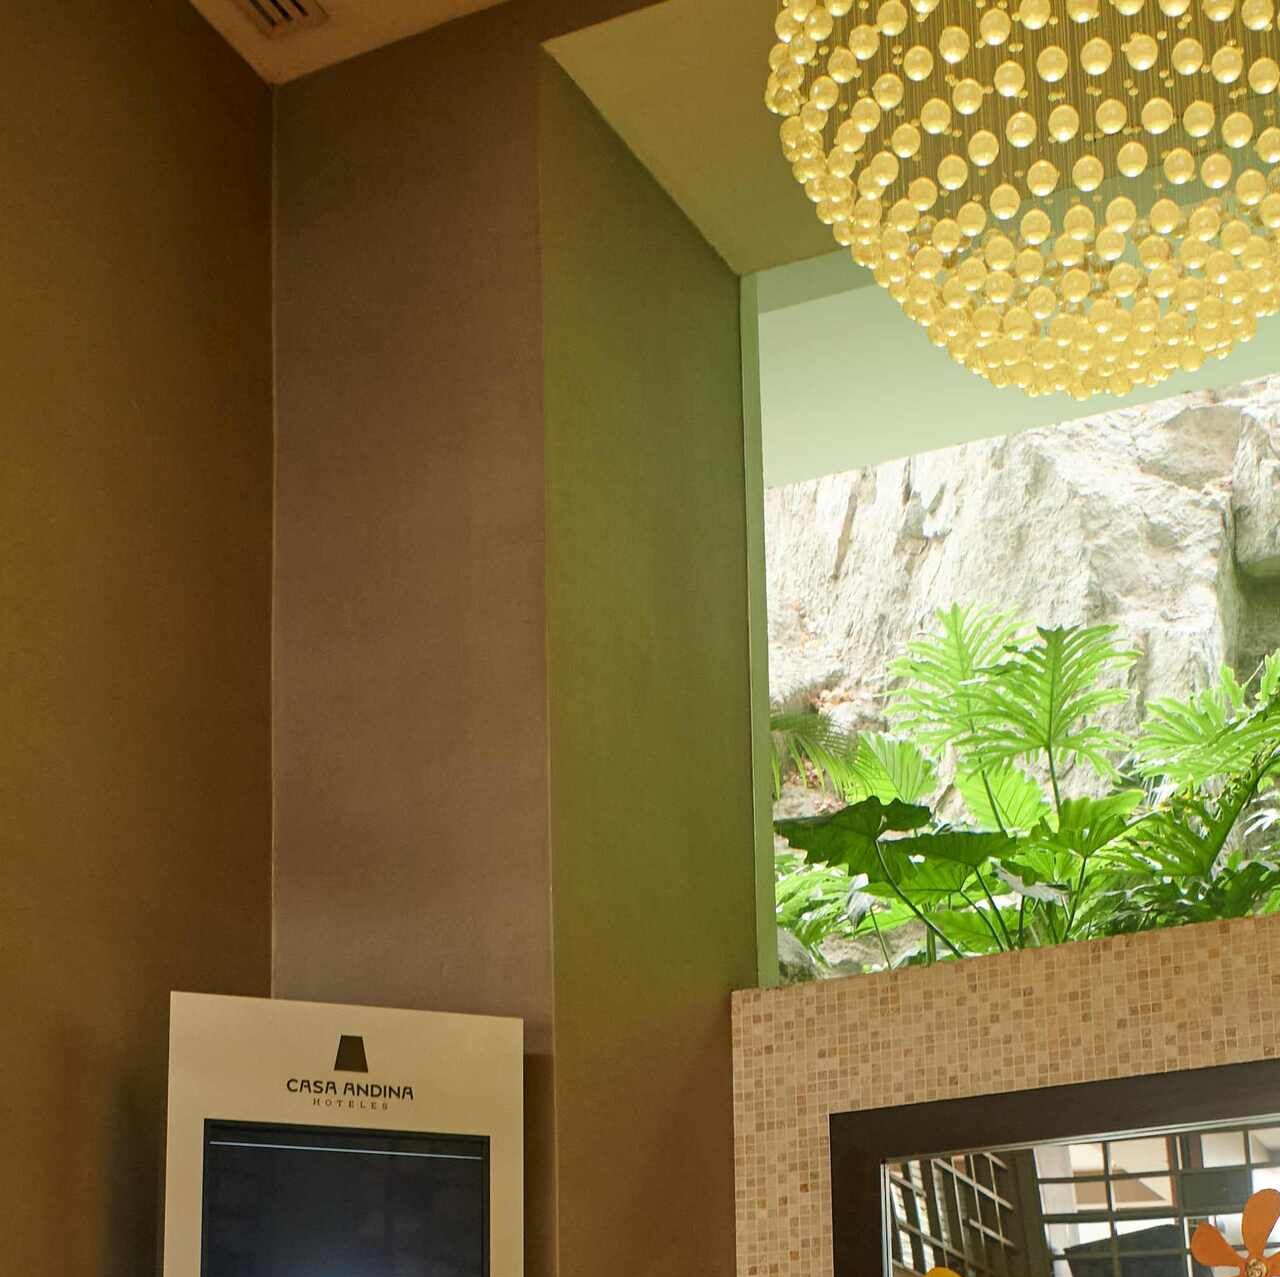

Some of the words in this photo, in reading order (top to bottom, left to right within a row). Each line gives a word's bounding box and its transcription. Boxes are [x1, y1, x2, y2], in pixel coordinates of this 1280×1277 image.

[286, 1078, 337, 1095] CASA
[343, 1082, 414, 1100] ANDINA
[312, 1097, 389, 1110] HOTELES
